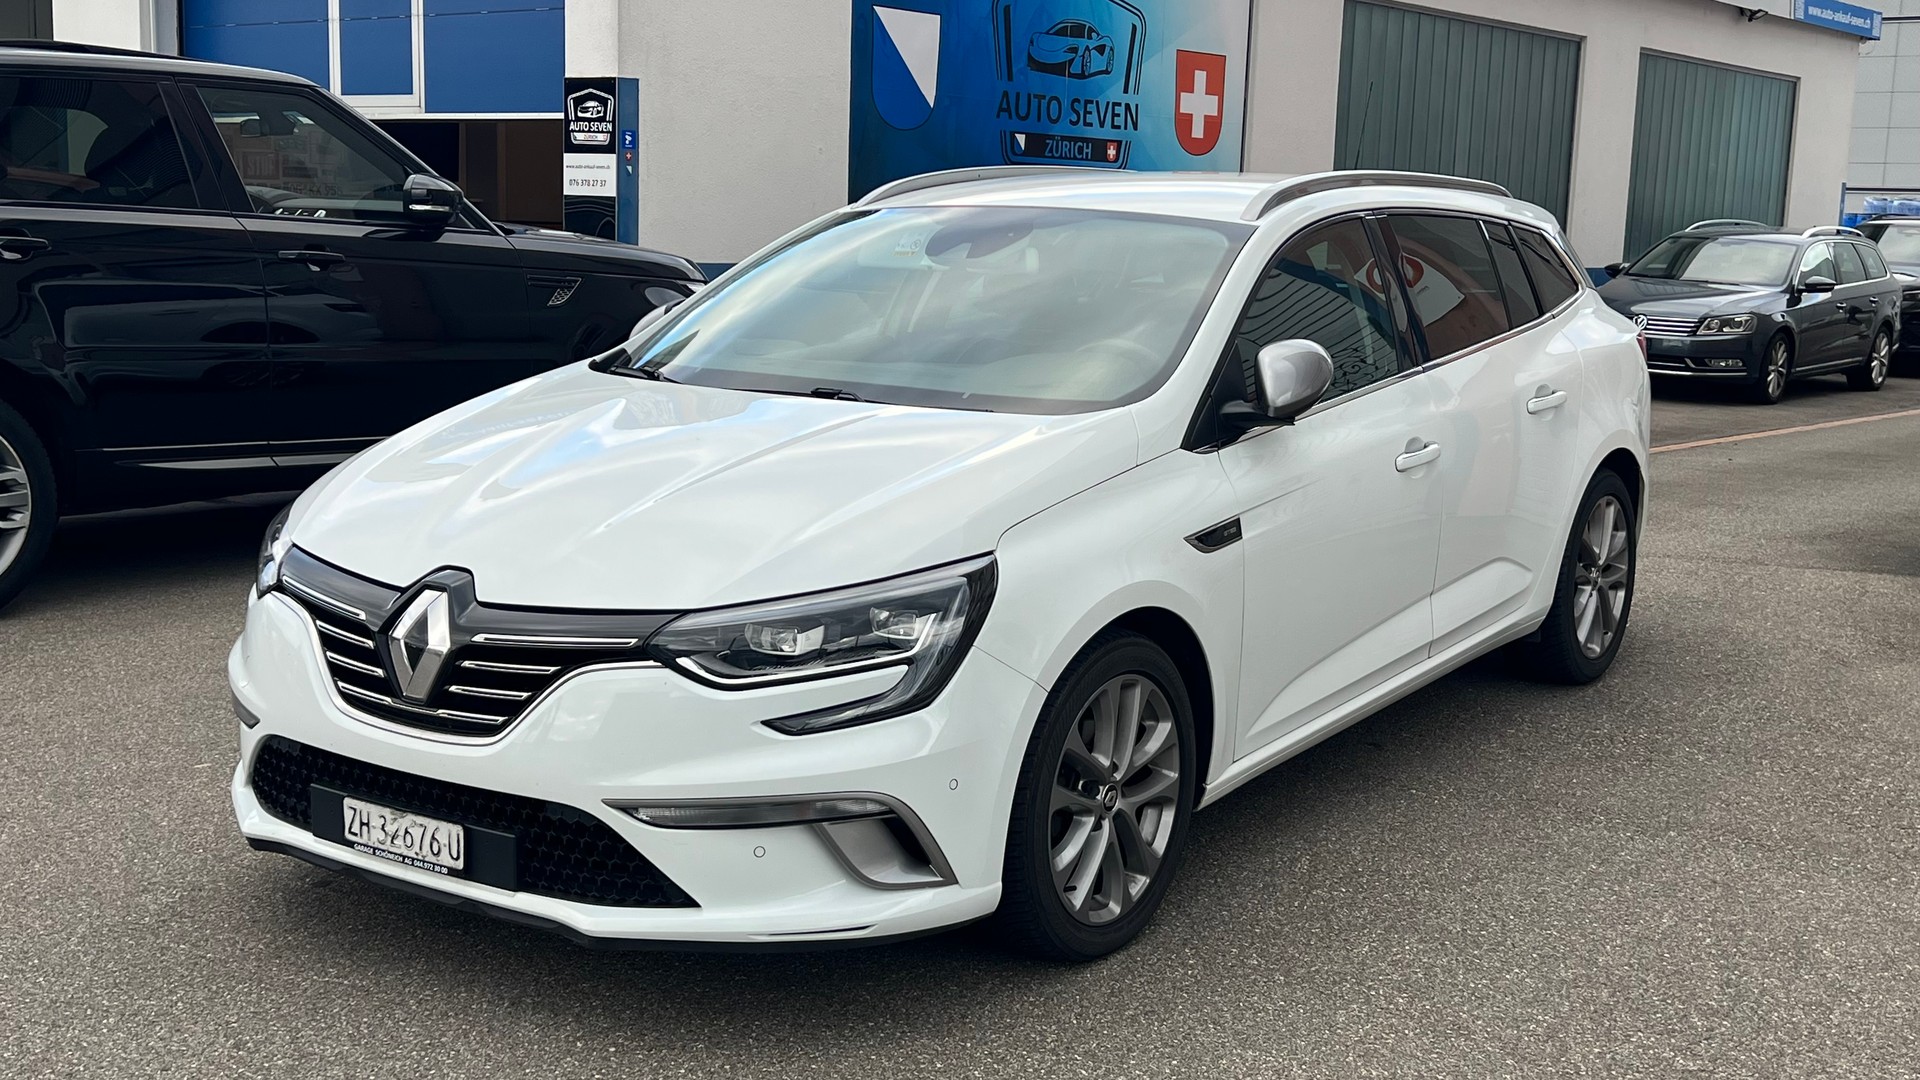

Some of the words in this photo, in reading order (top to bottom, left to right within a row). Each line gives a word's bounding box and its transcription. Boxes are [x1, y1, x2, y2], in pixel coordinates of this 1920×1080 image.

[996, 90, 1063, 125] AUTO
[1068, 97, 1139, 132] SEVEN
[569, 121, 589, 132] AUTO
[590, 122, 613, 132] SEVEN
[1044, 137, 1092, 160] ZÜRICH
[569, 179, 580, 187] 076
[580, 179, 591, 187] 378
[592, 179, 599, 187] 27
[353, 843, 374, 855] GARAGE
[404, 857, 413, 866] AG
